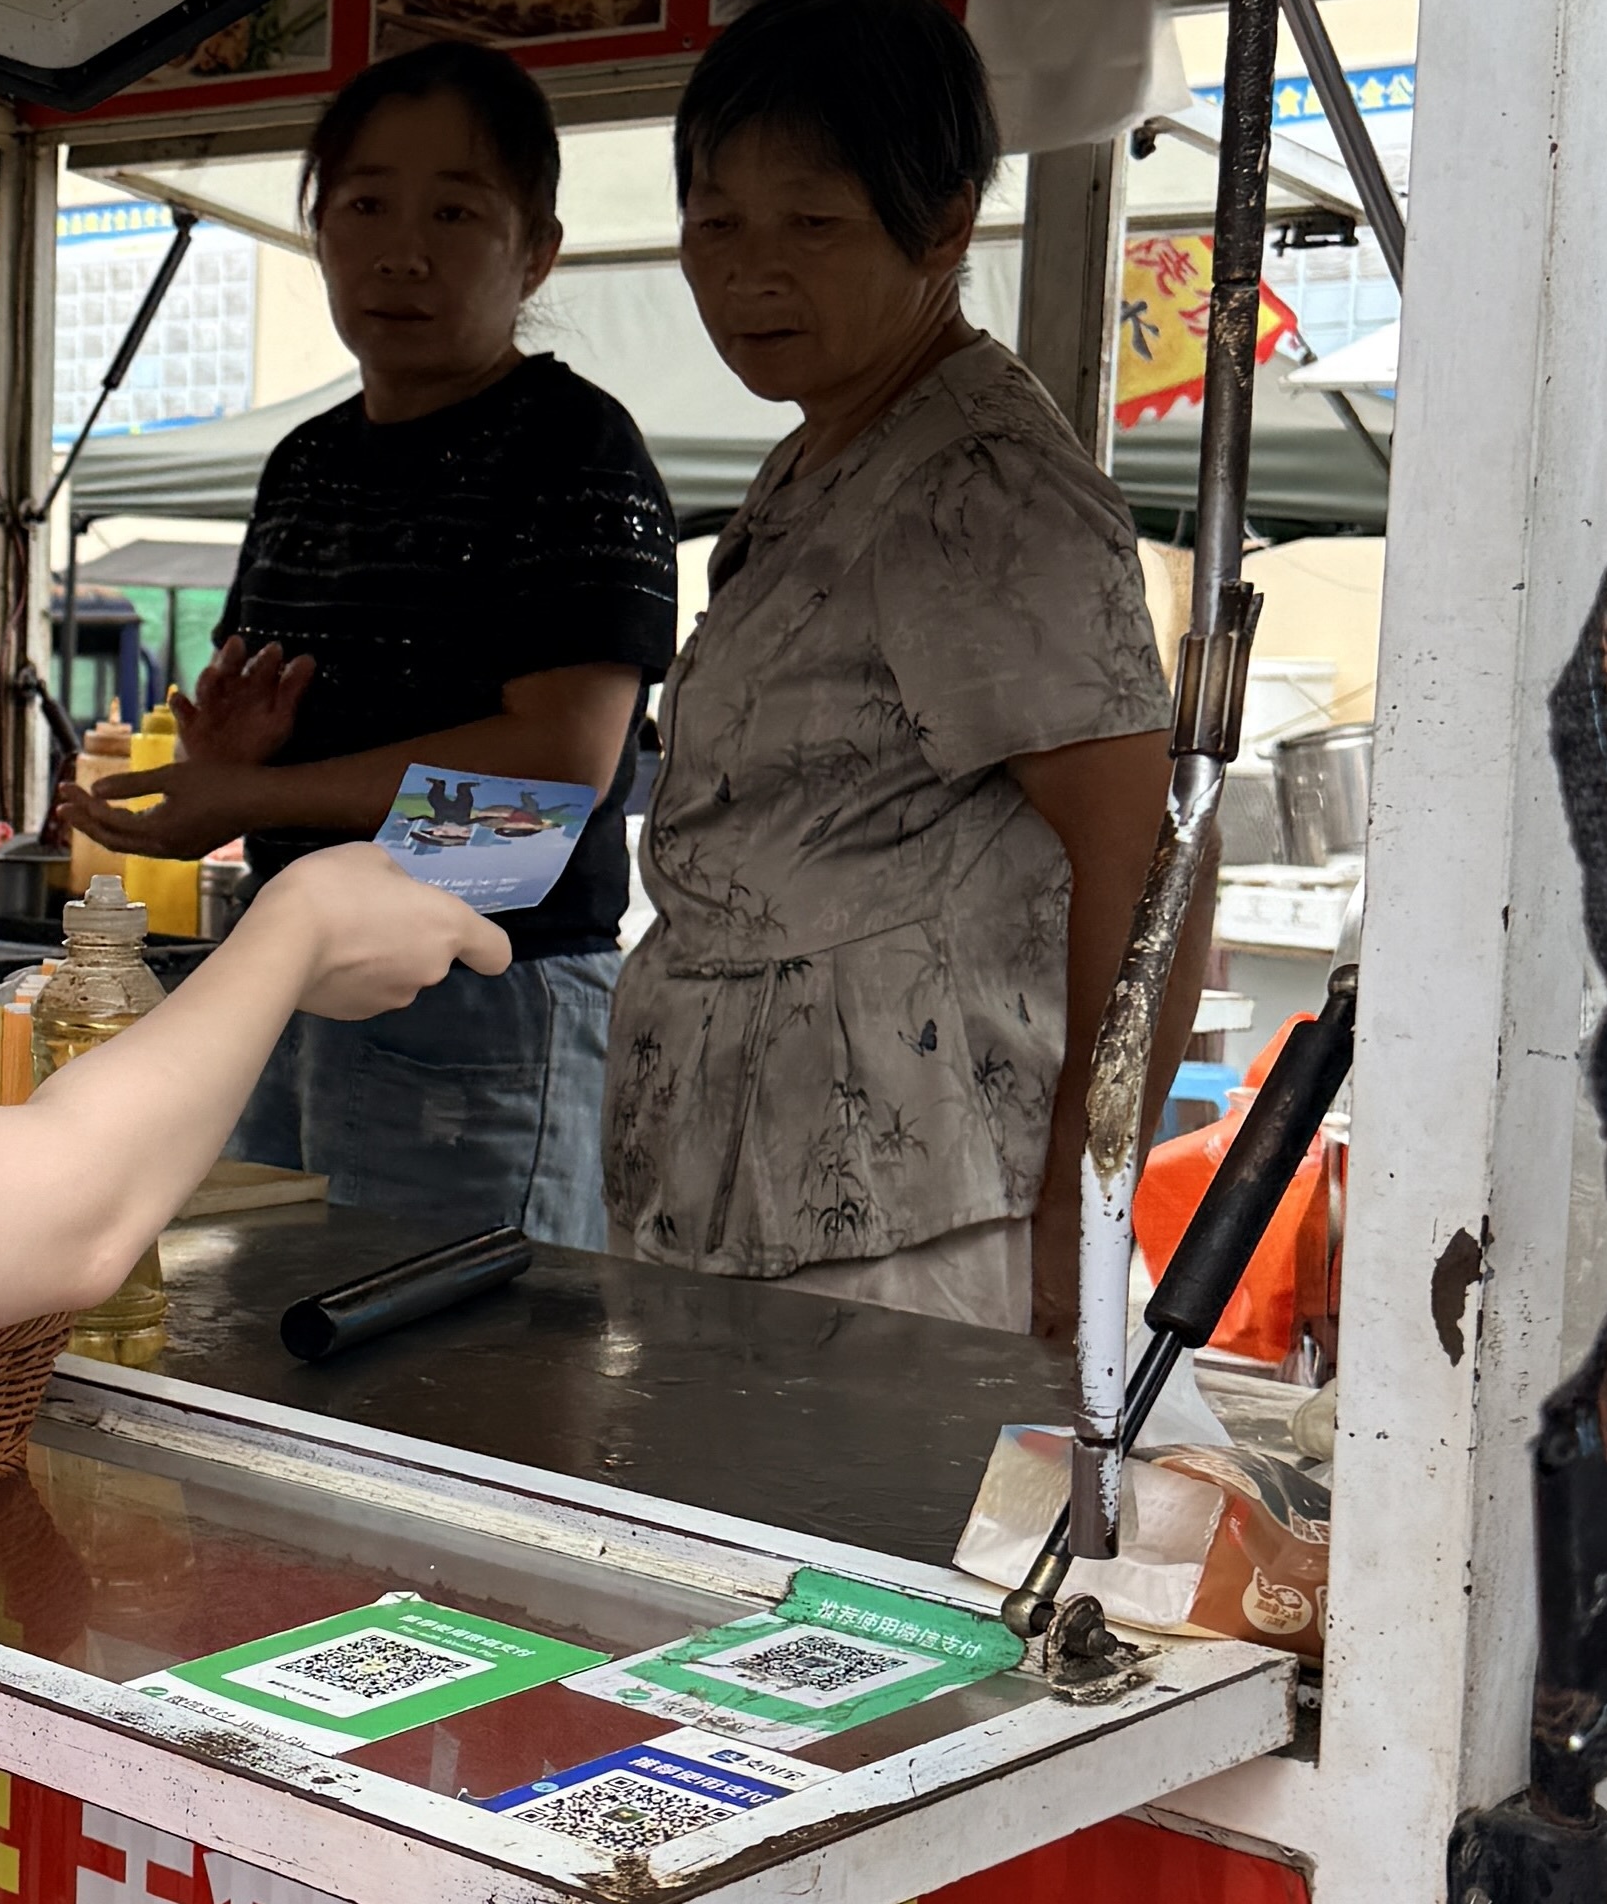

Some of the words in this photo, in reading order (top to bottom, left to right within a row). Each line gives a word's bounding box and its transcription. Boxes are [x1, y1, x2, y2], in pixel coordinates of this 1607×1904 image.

[814, 1598, 983, 1661] 推荐使用微信支付
[628, 1755, 778, 1805] 推荐使用支付
[744, 1754, 807, 1784] 支付宝
